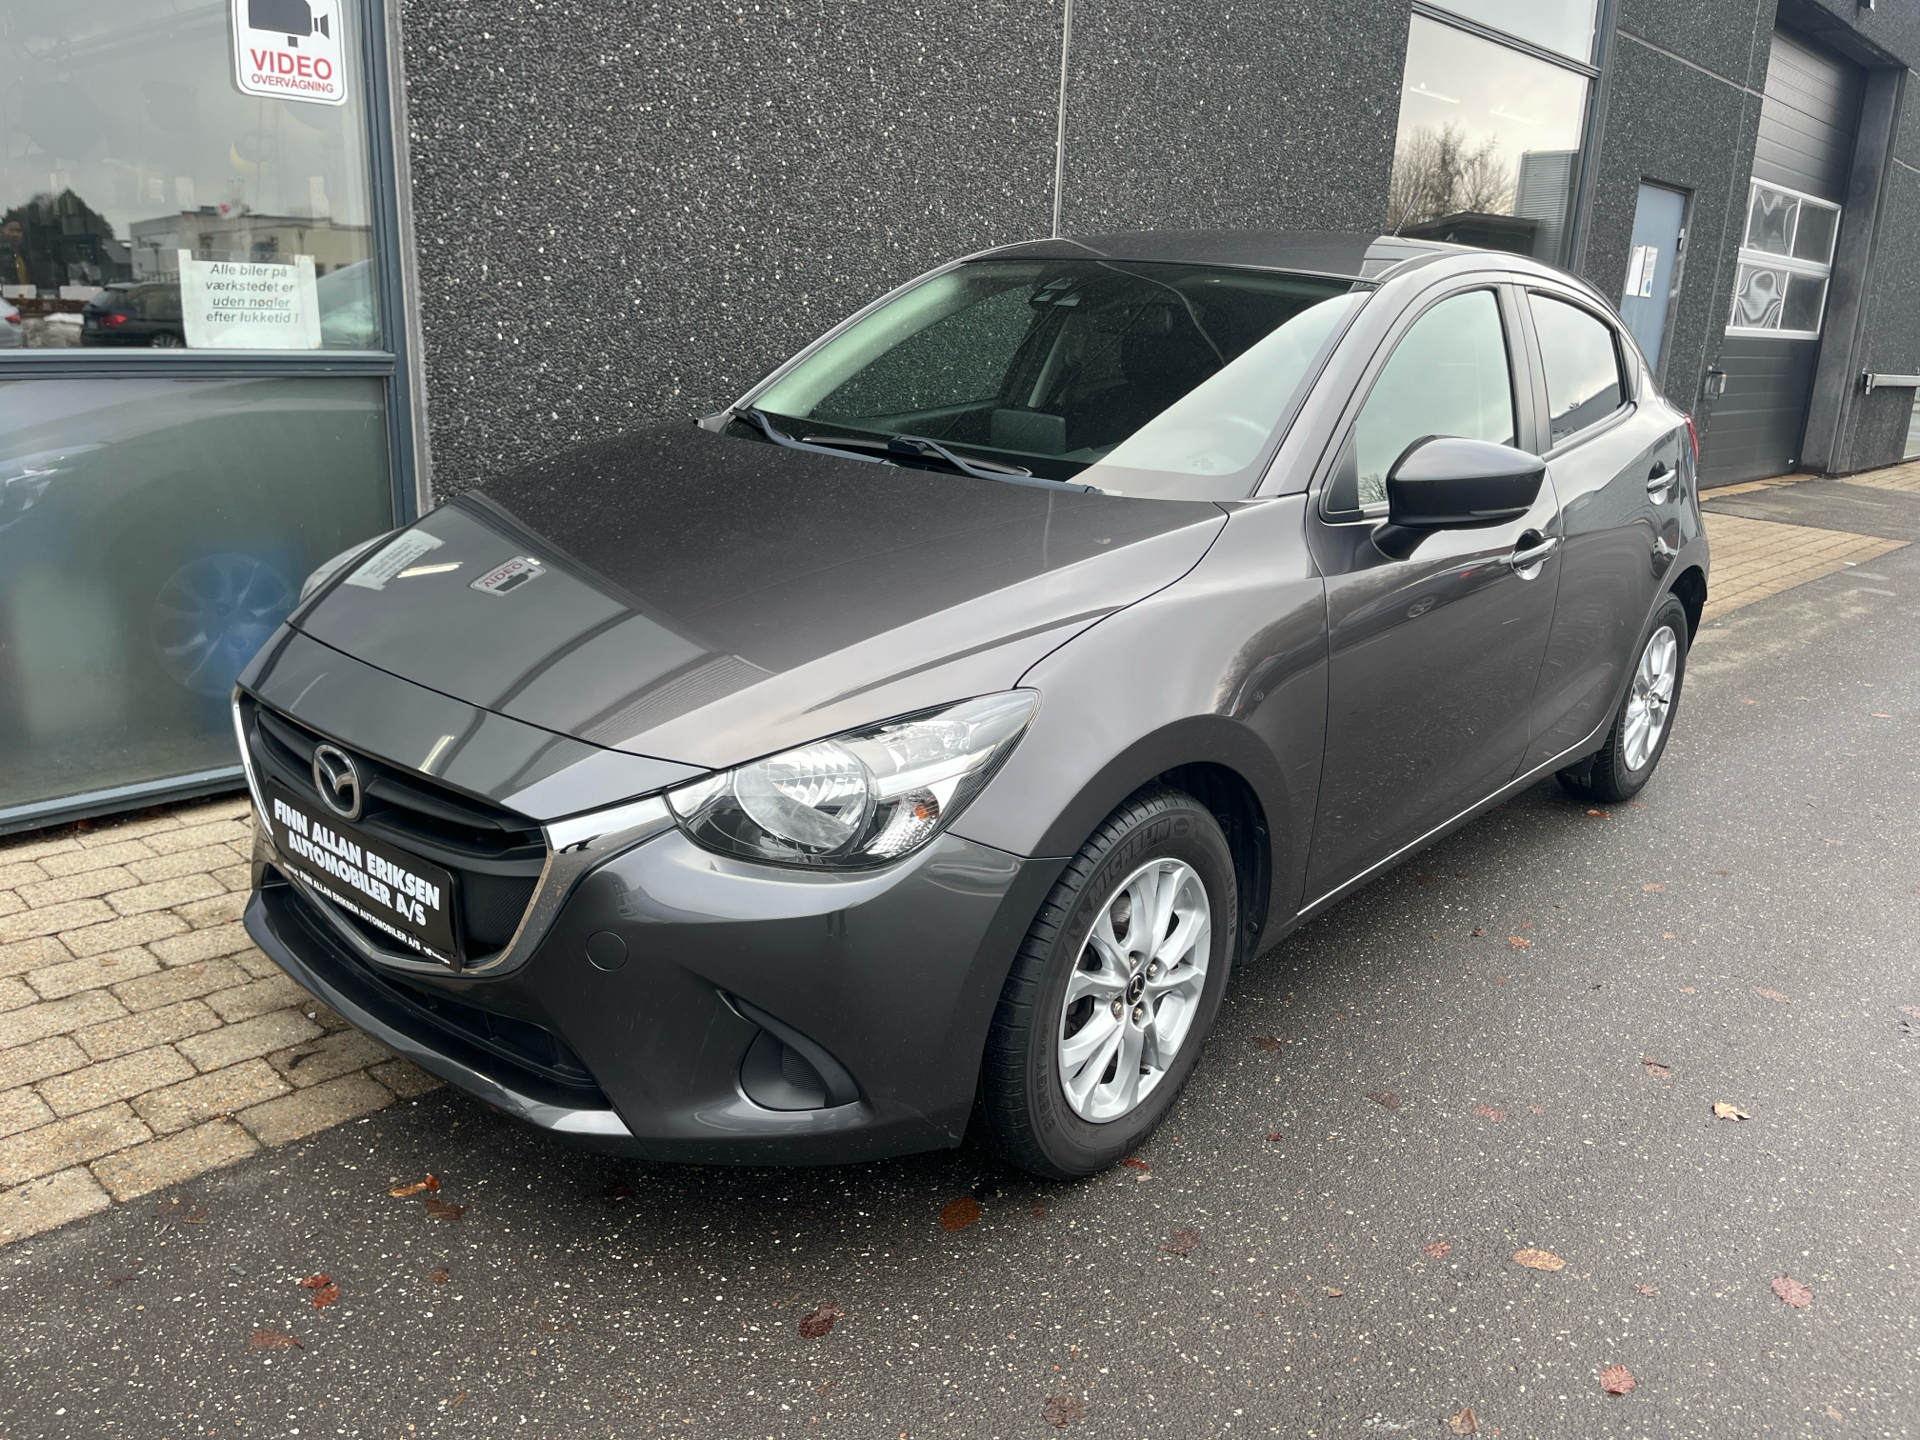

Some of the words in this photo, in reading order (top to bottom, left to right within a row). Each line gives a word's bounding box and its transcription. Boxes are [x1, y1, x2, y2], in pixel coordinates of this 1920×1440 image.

[249, 48, 333, 80] VIDEO
[251, 73, 334, 94] OVERVÅGNING
[205, 280, 279, 292] værkstedet
[281, 284, 296, 293] er
[210, 264, 237, 275] Alle
[240, 265, 269, 277] biler
[271, 266, 288, 279] på
[206, 311, 237, 323] efter
[240, 311, 291, 324] lukketid
[212, 296, 245, 308] uden
[249, 297, 291, 310] nøgler
[274, 798, 308, 836] FINN
[312, 822, 362, 869] ALLAN
[366, 851, 440, 911] ERIKSEN
[1088, 818, 1170, 908] MICHELIN
[288, 830, 392, 909] AUTOMOBILER
[396, 893, 427, 927] A/S
[299, 870, 313, 885] FINN
[313, 879, 332, 898] ALLAN
[332, 891, 359, 915] ERIKSEN
[360, 909, 408, 942] AUTOMOBILER
[408, 937, 421, 951] A/S
[1036, 1062, 1056, 1134] ENERGY
